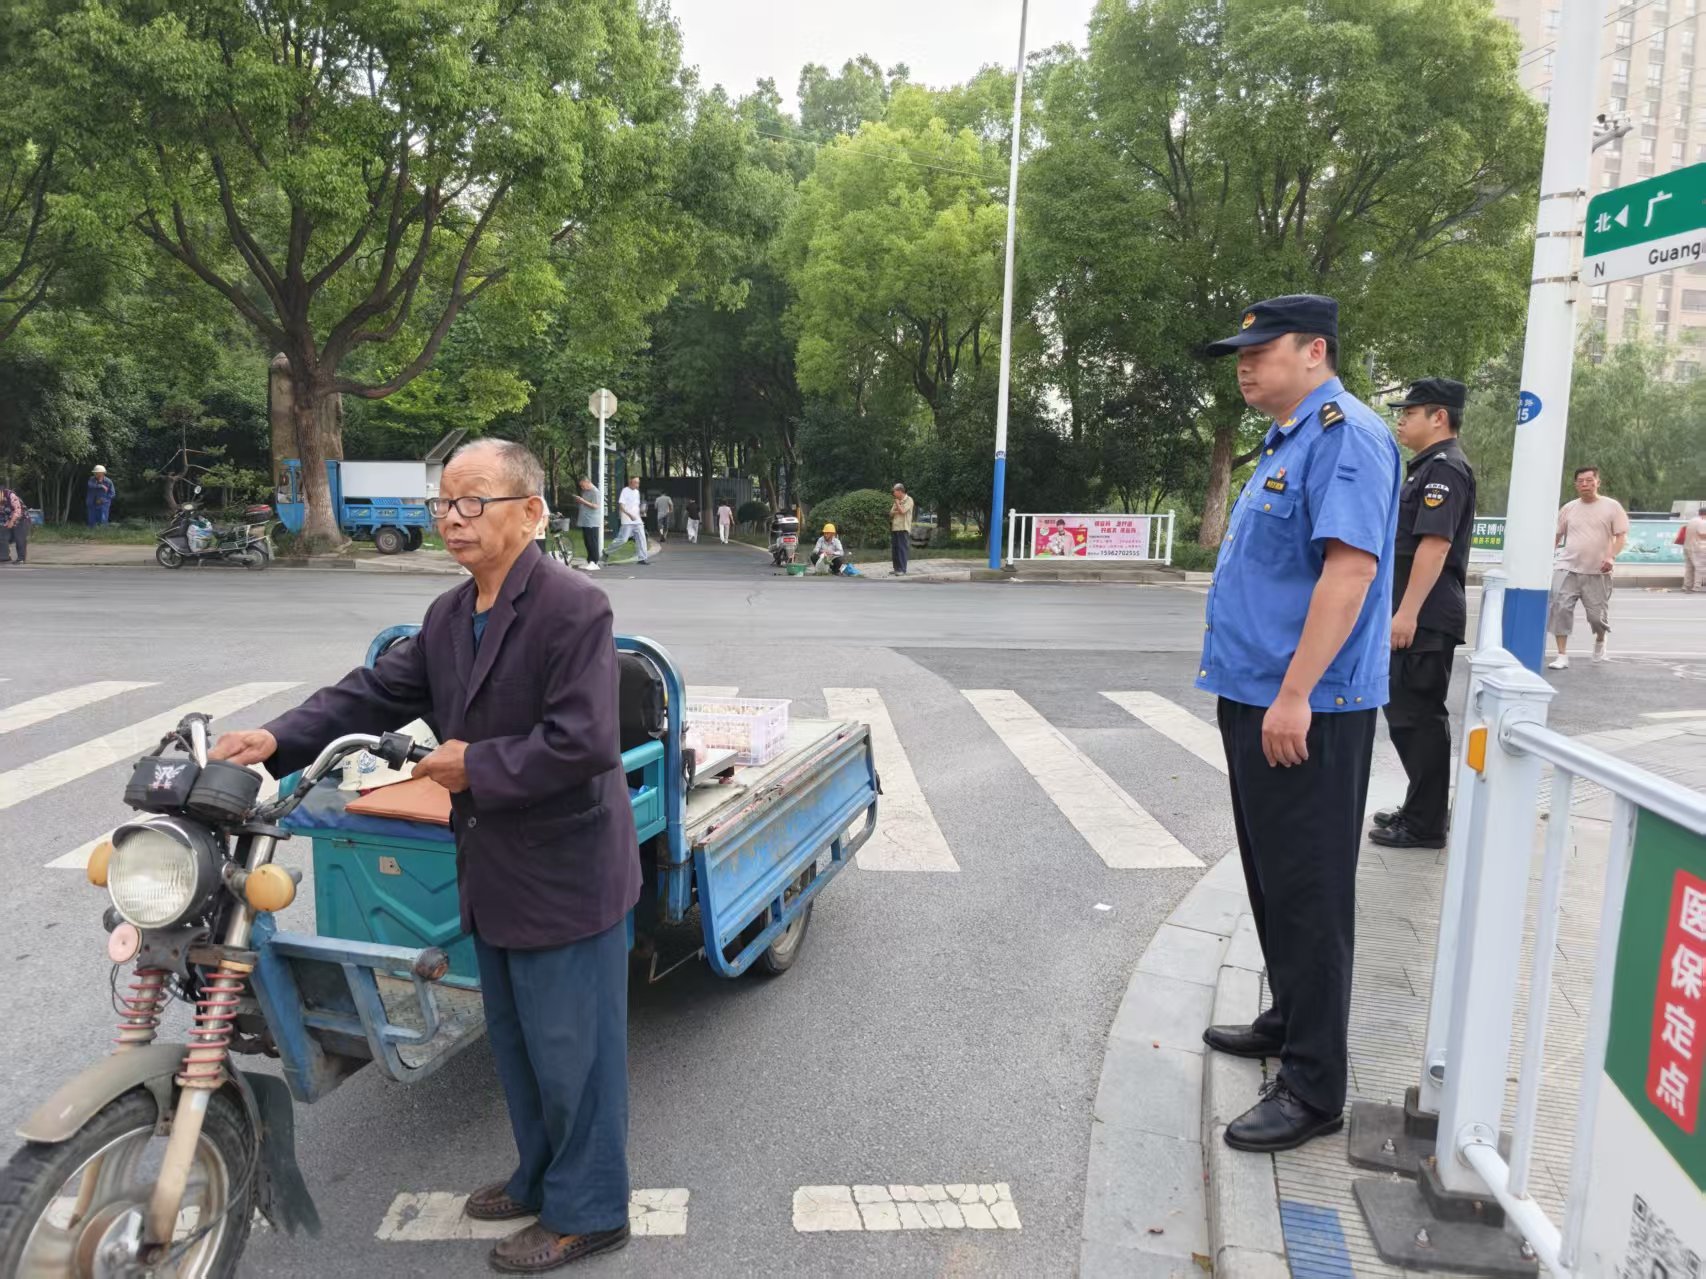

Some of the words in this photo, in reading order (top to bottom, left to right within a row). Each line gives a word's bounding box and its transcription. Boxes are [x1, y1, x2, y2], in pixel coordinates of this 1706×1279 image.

[1594, 212, 1612, 233] 北
[1648, 242, 1704, 265] Guang
[1594, 262, 1605, 278] N
[1655, 885, 1706, 1117] 医保定点
